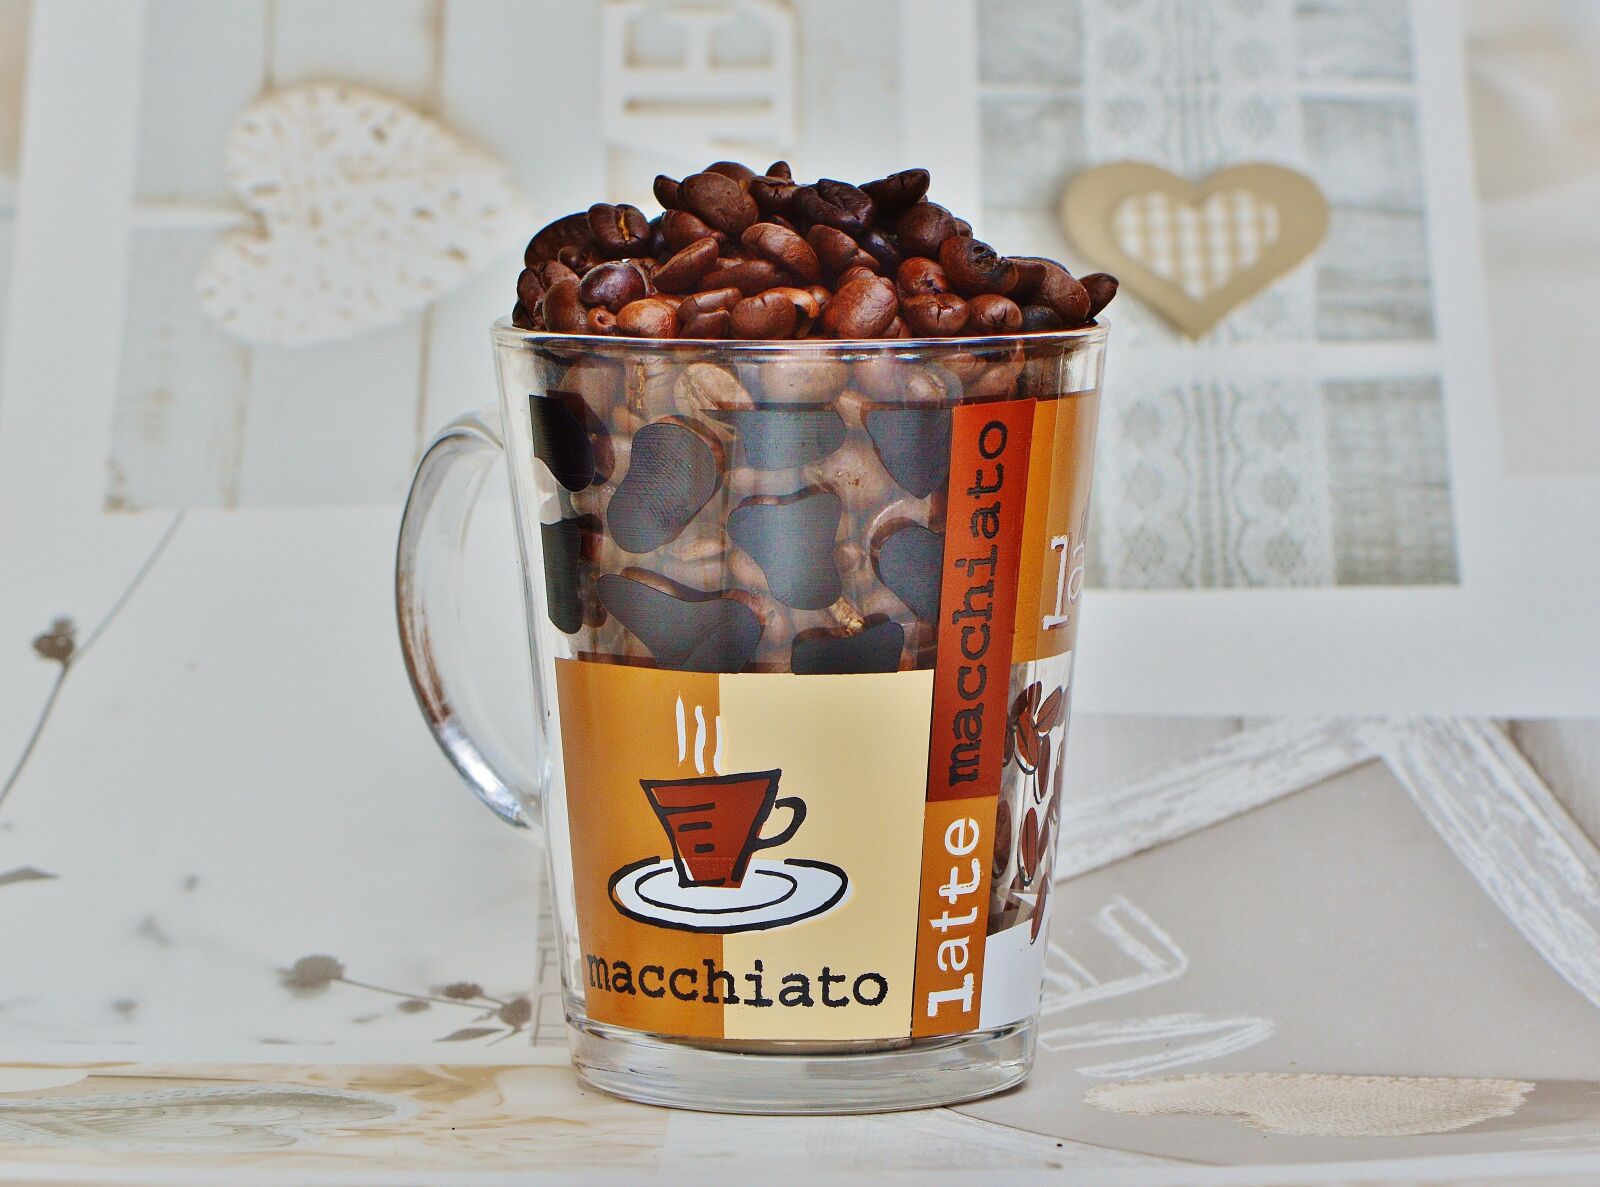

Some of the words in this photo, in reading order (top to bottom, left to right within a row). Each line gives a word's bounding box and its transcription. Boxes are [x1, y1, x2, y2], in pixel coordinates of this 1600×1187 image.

[949, 419, 1009, 787] macchiato
[586, 953, 889, 1008] macchiato
[927, 817, 982, 1017] latte
